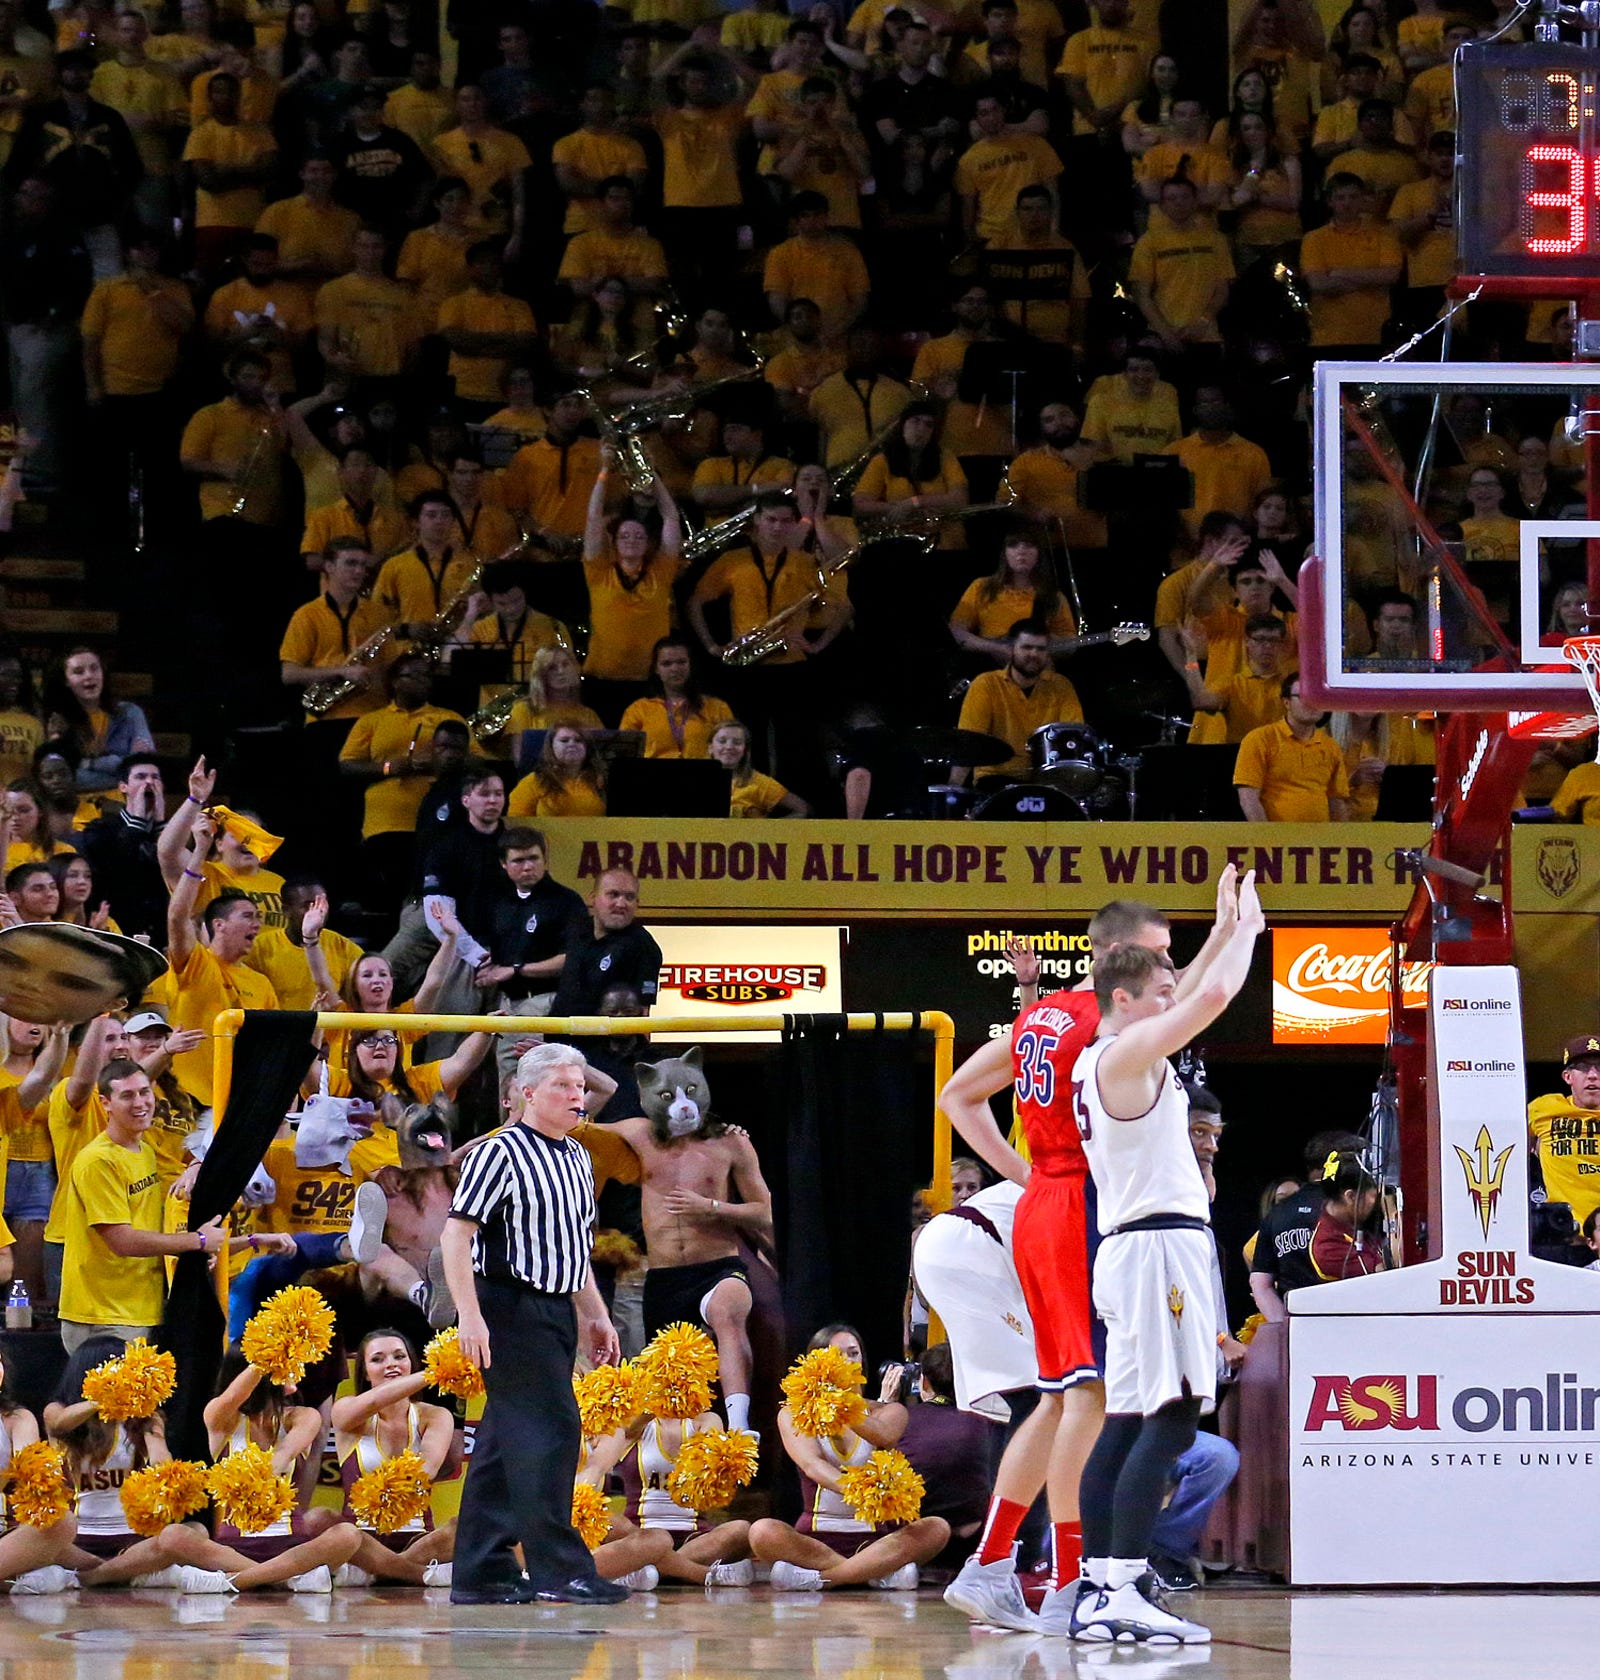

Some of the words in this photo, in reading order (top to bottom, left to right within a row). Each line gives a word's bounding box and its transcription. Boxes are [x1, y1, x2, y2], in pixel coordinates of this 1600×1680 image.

[576, 840, 788, 882] ABANDON
[801, 843, 880, 883] ALL
[893, 844, 1007, 884] HOPE
[1024, 845, 1083, 885] YE
[1100, 845, 1210, 885] WHO
[1227, 846, 1374, 886] ENTER
[658, 966, 822, 993] FIREHOUSE
[706, 984, 769, 1001] SUBS
[1442, 999, 1468, 1011] ASU
[1470, 998, 1512, 1011] online
[1014, 1030, 1060, 1108] 35
[1446, 1060, 1473, 1073] ASU
[1474, 1059, 1516, 1073] online
[1550, 1117, 1582, 1141] NO
[1551, 1140, 1572, 1157] FOR
[1577, 1139, 1599, 1156] THE
[291, 1179, 357, 1219] 942
[1457, 1251, 1516, 1278] SUN
[1440, 1279, 1536, 1306] DEVILS
[1304, 1375, 1441, 1432] ASU
[1302, 1454, 1414, 1467] ARIZONA
[1431, 1453, 1503, 1467] STATE
[81, 1469, 124, 1491] ASU
